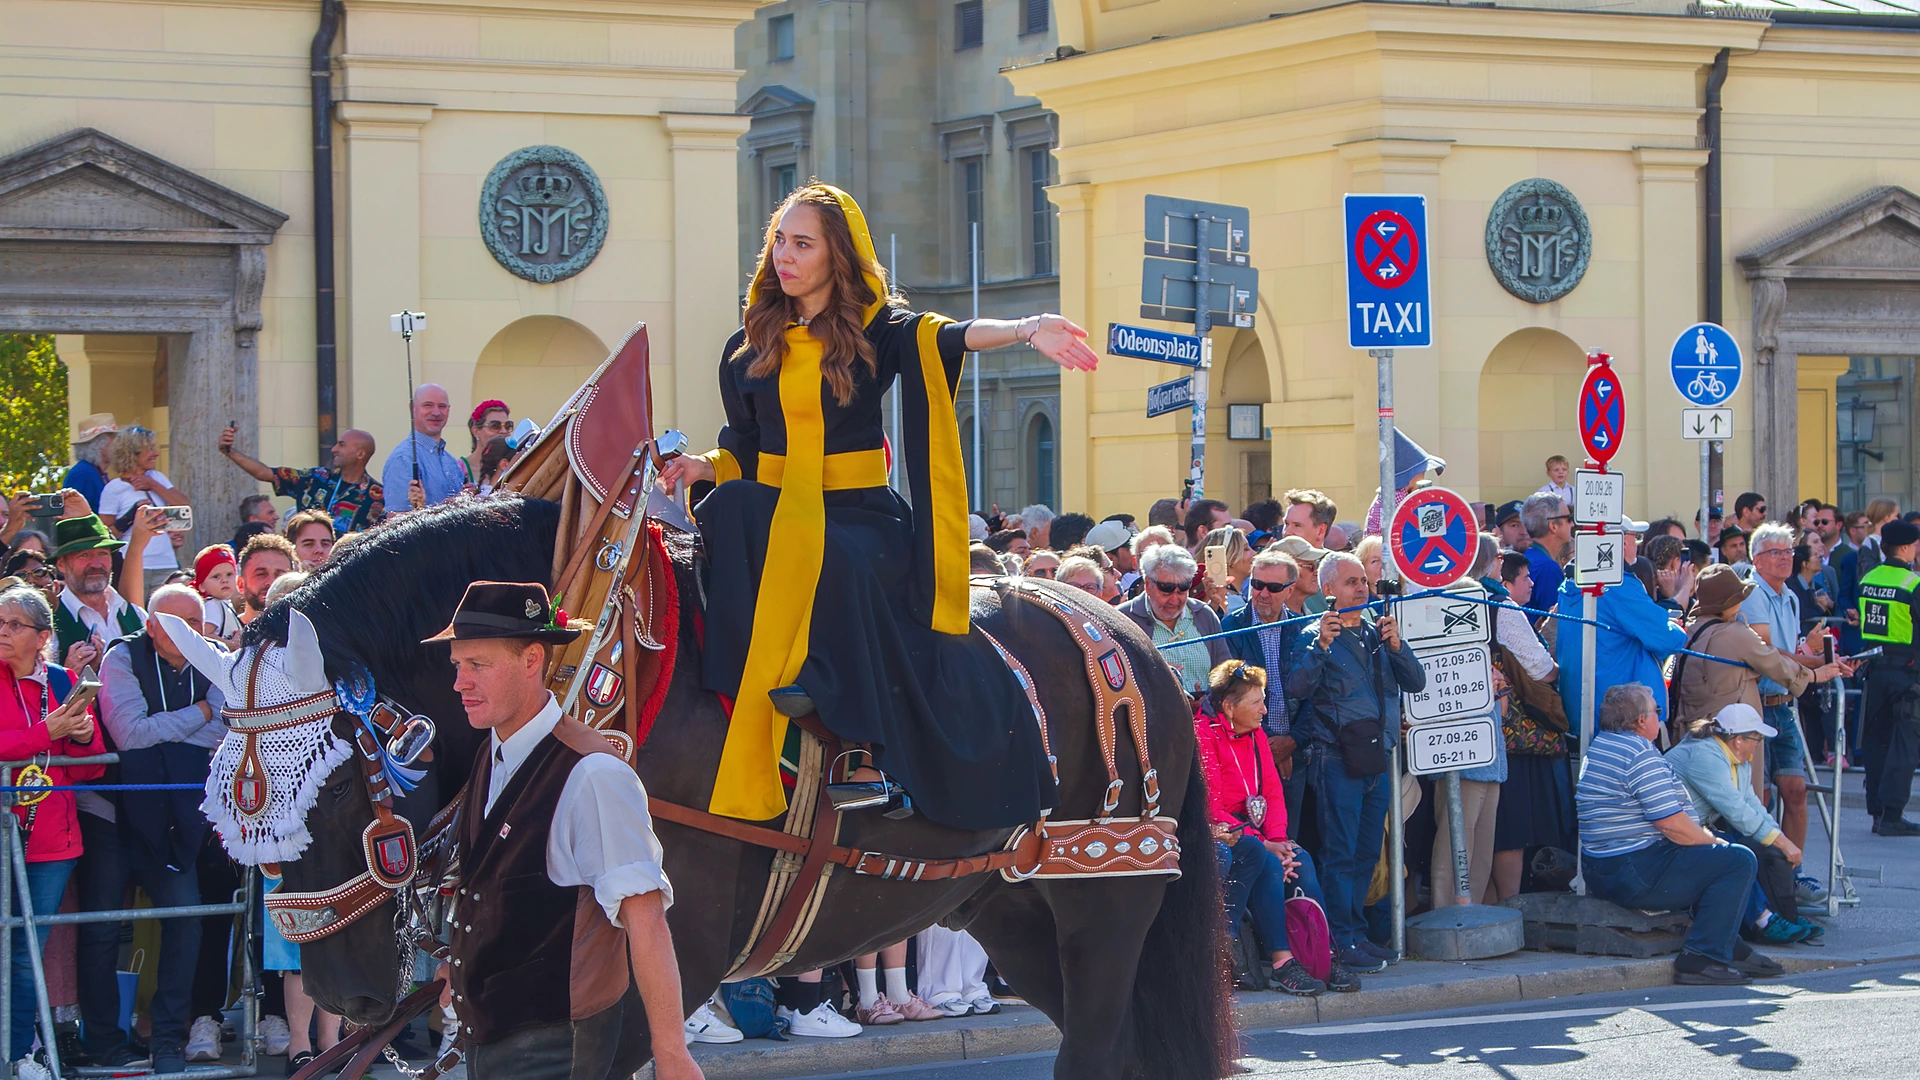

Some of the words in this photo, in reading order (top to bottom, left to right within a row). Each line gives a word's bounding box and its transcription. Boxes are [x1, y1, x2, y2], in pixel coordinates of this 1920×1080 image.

[1356, 302, 1422, 334] TAXI
[1118, 328, 1199, 360] Odeonsplatz
[1585, 480, 1612, 496] 20.09.26
[1421, 510, 1443, 524] CRASH
[1589, 501, 1608, 517] 6-14h
[1862, 585, 1897, 598] POLIZEI
[1871, 604, 1882, 614] BY
[1866, 613, 1887, 626] 1231
[1435, 651, 1482, 669] 12.09.26
[1435, 672, 1449, 684] 07
[1452, 670, 1460, 680] h
[1413, 691, 1430, 703] bis
[1438, 680, 1485, 698] 14.09.26
[1438, 702, 1452, 713] 03
[1455, 700, 1463, 710] h
[1428, 730, 1478, 746] 27.09.26
[1432, 751, 1464, 765] 05-21
[1469, 749, 1476, 760] h
